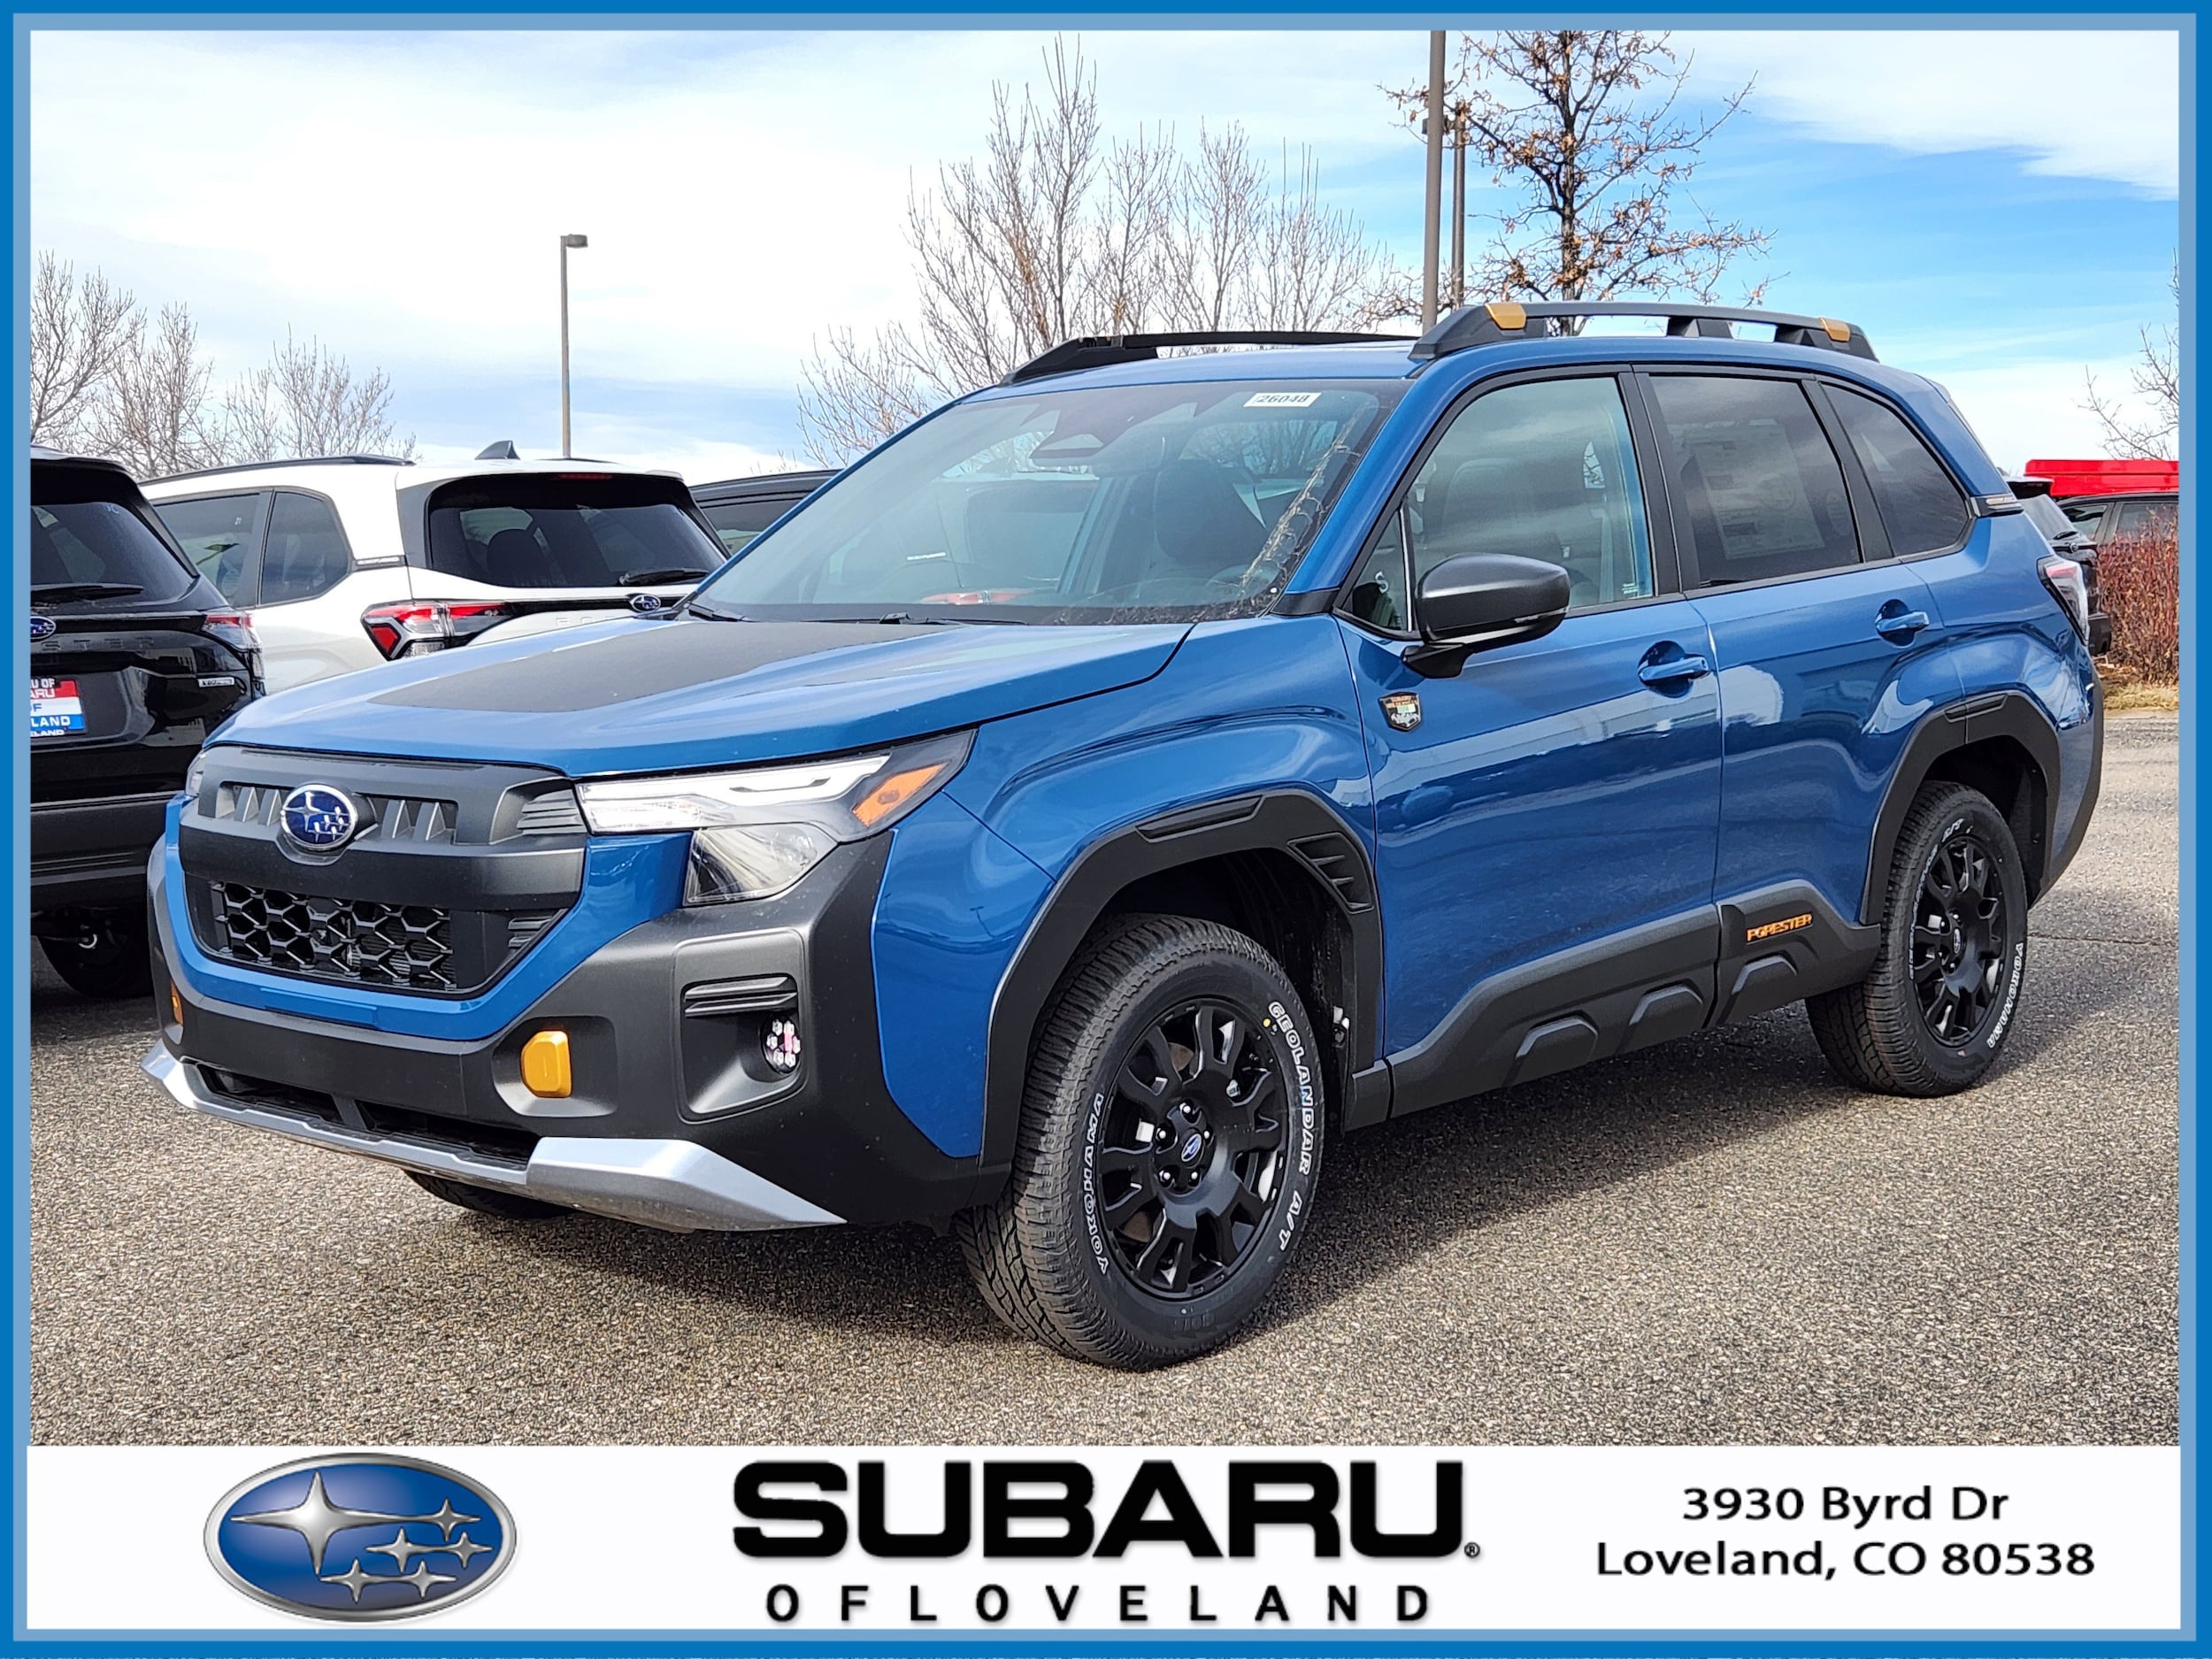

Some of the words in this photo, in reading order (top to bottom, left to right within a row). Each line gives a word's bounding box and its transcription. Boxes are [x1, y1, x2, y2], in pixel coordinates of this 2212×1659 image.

[1747, 913, 1813, 942] FORESTER
[1986, 942, 2024, 1048] YOKOHAMA
[1268, 1001, 1313, 1176] GEOLANDAR
[1079, 1093, 1108, 1274] YOKOHAMA
[1278, 1190, 1303, 1252] A/T
